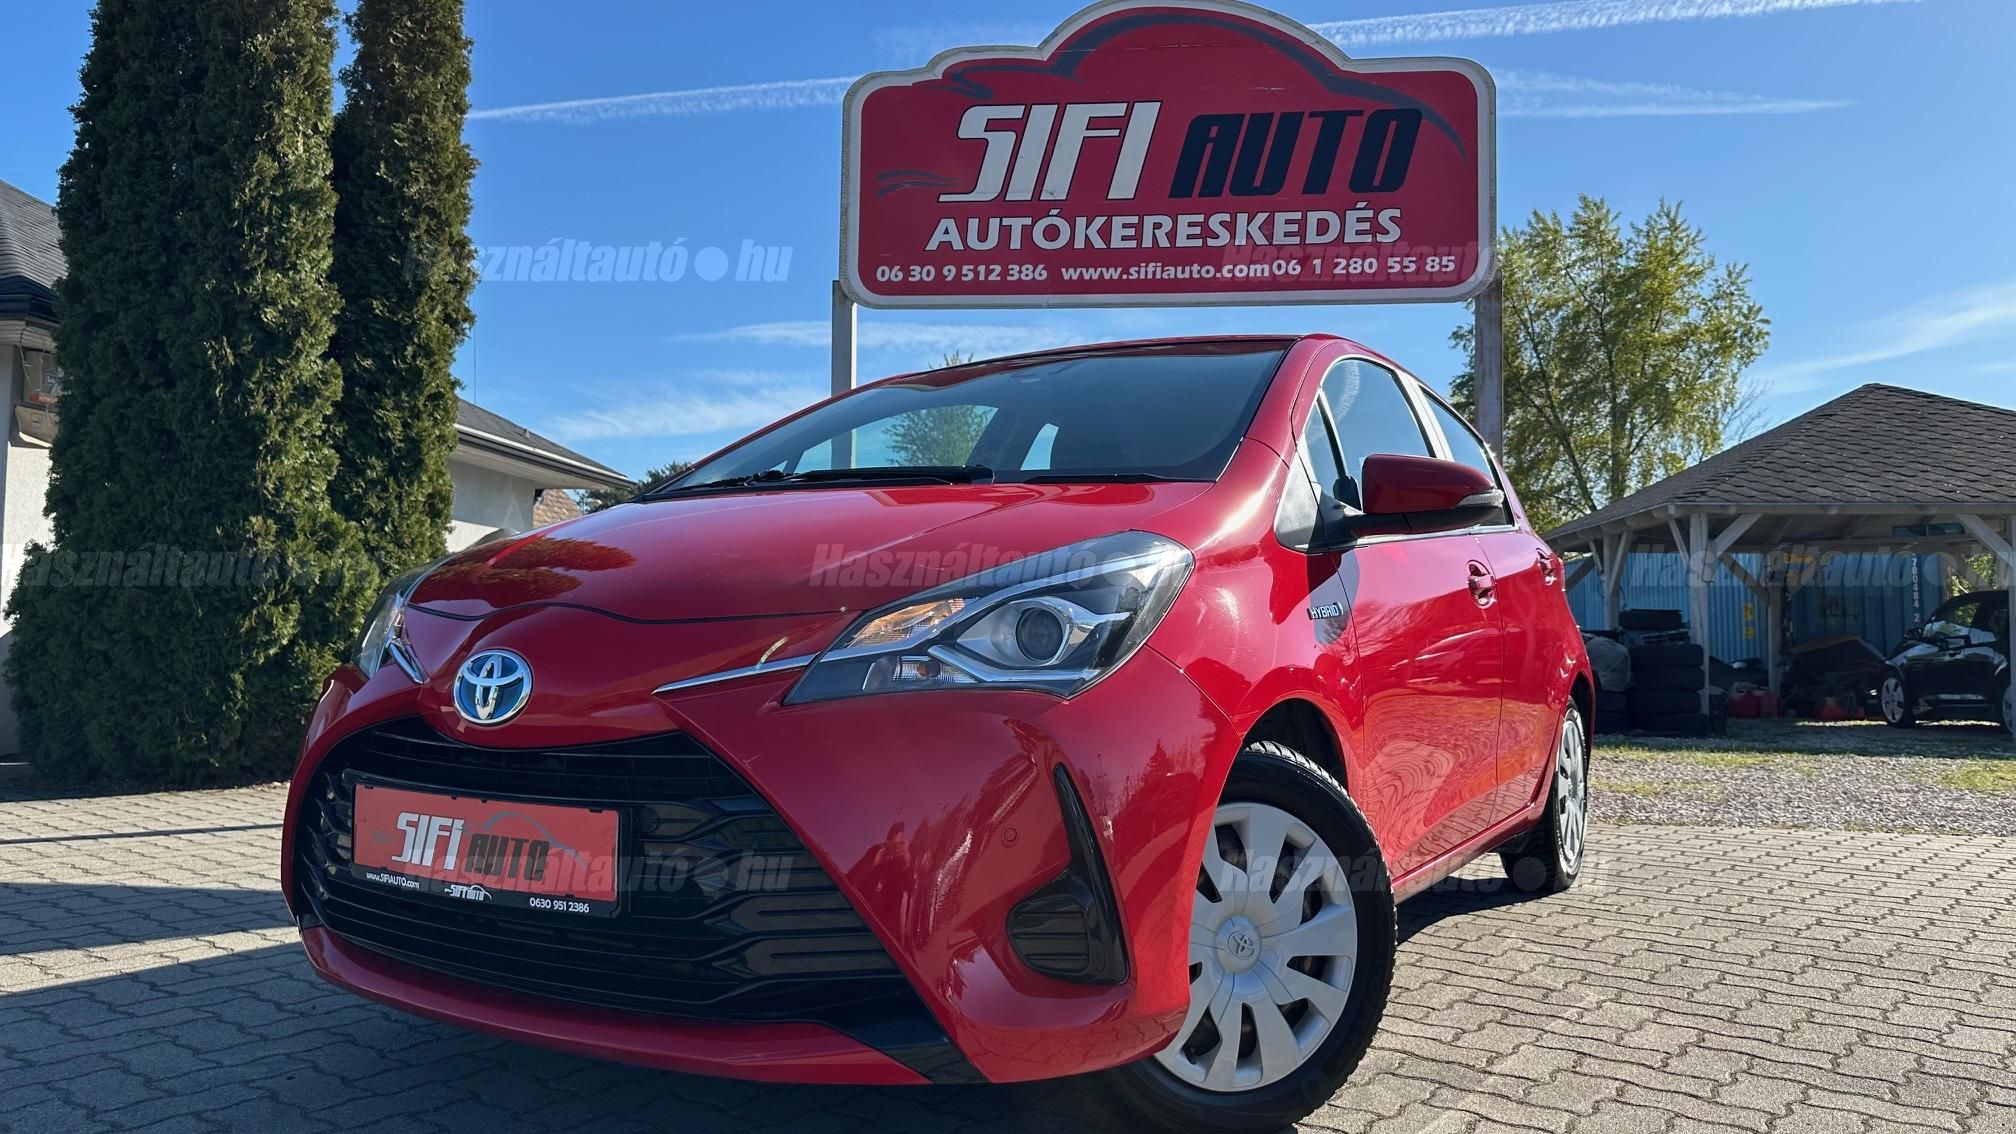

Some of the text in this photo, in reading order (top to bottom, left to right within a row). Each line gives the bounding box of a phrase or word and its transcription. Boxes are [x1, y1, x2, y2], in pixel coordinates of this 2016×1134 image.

[937, 101, 1422, 202] SIFI AUTO
[924, 202, 1402, 250] AUTÓKERESKEDÉS
[876, 265, 903, 281] 06
[908, 265, 936, 281] 30
[1006, 264, 1048, 281] 386
[1061, 261, 1270, 281] www.sifiauto.com
[1272, 256, 1455, 276] 06 1 280 55 85
[1309, 604, 1339, 619] HYBRID
[391, 811, 549, 881] SIFI AUTO
[529, 897, 590, 913] 0630 951 2386
